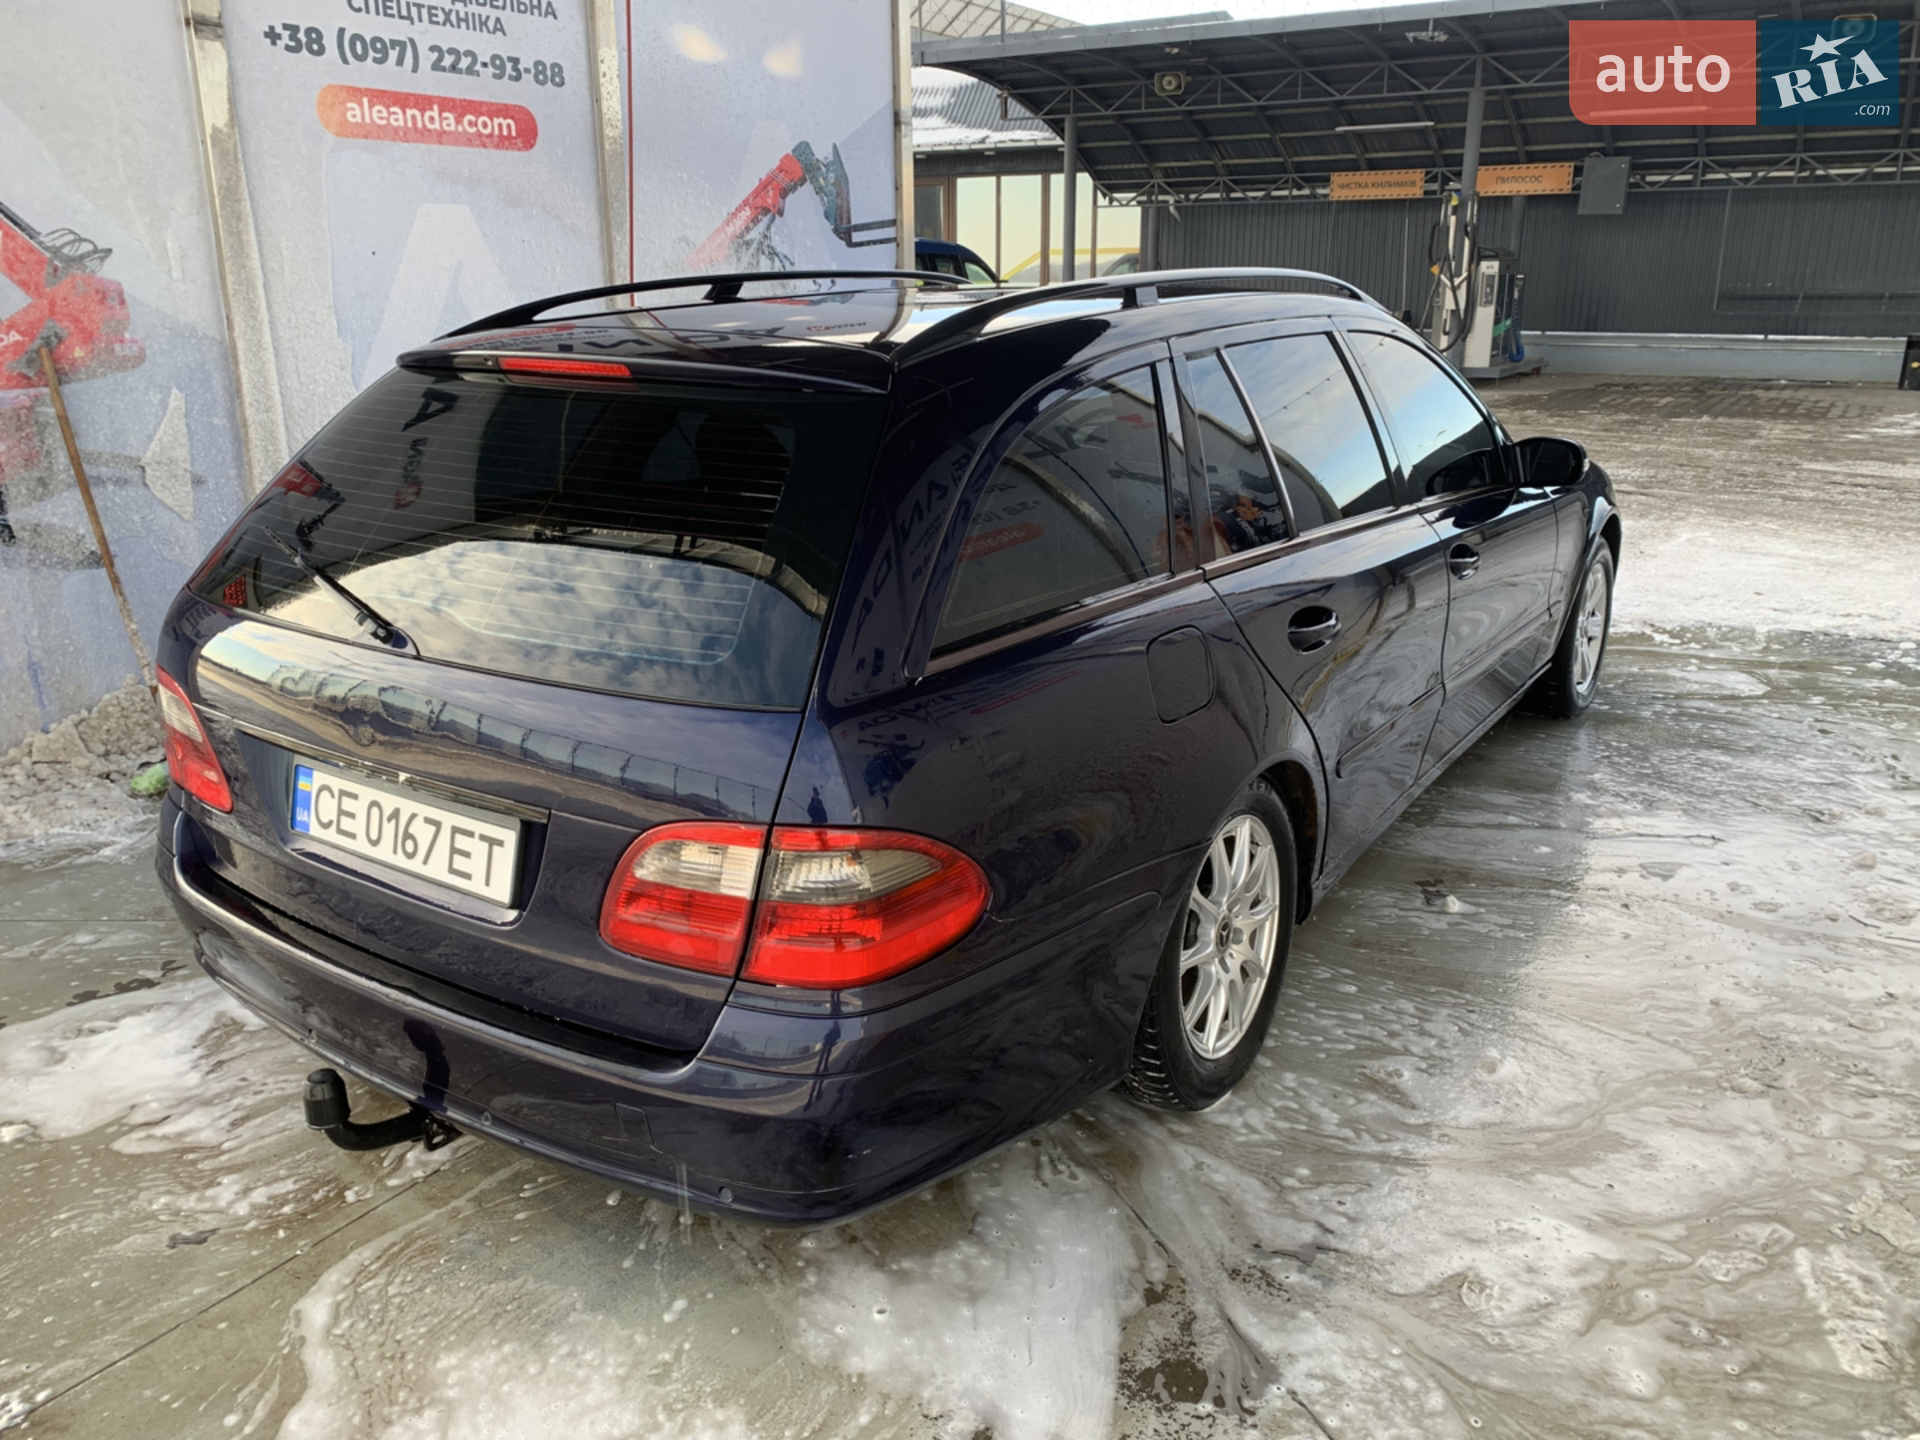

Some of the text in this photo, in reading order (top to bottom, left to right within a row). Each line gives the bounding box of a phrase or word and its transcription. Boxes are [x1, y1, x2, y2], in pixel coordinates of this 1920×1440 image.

[263, 23, 566, 88] +38 (097) 222-93-88
[345, 97, 517, 137] aleanda.com
[1337, 181, 1370, 191] ЧИСТКА
[1495, 174, 1543, 186] ПИЛОСОС
[296, 806, 310, 823] UA
